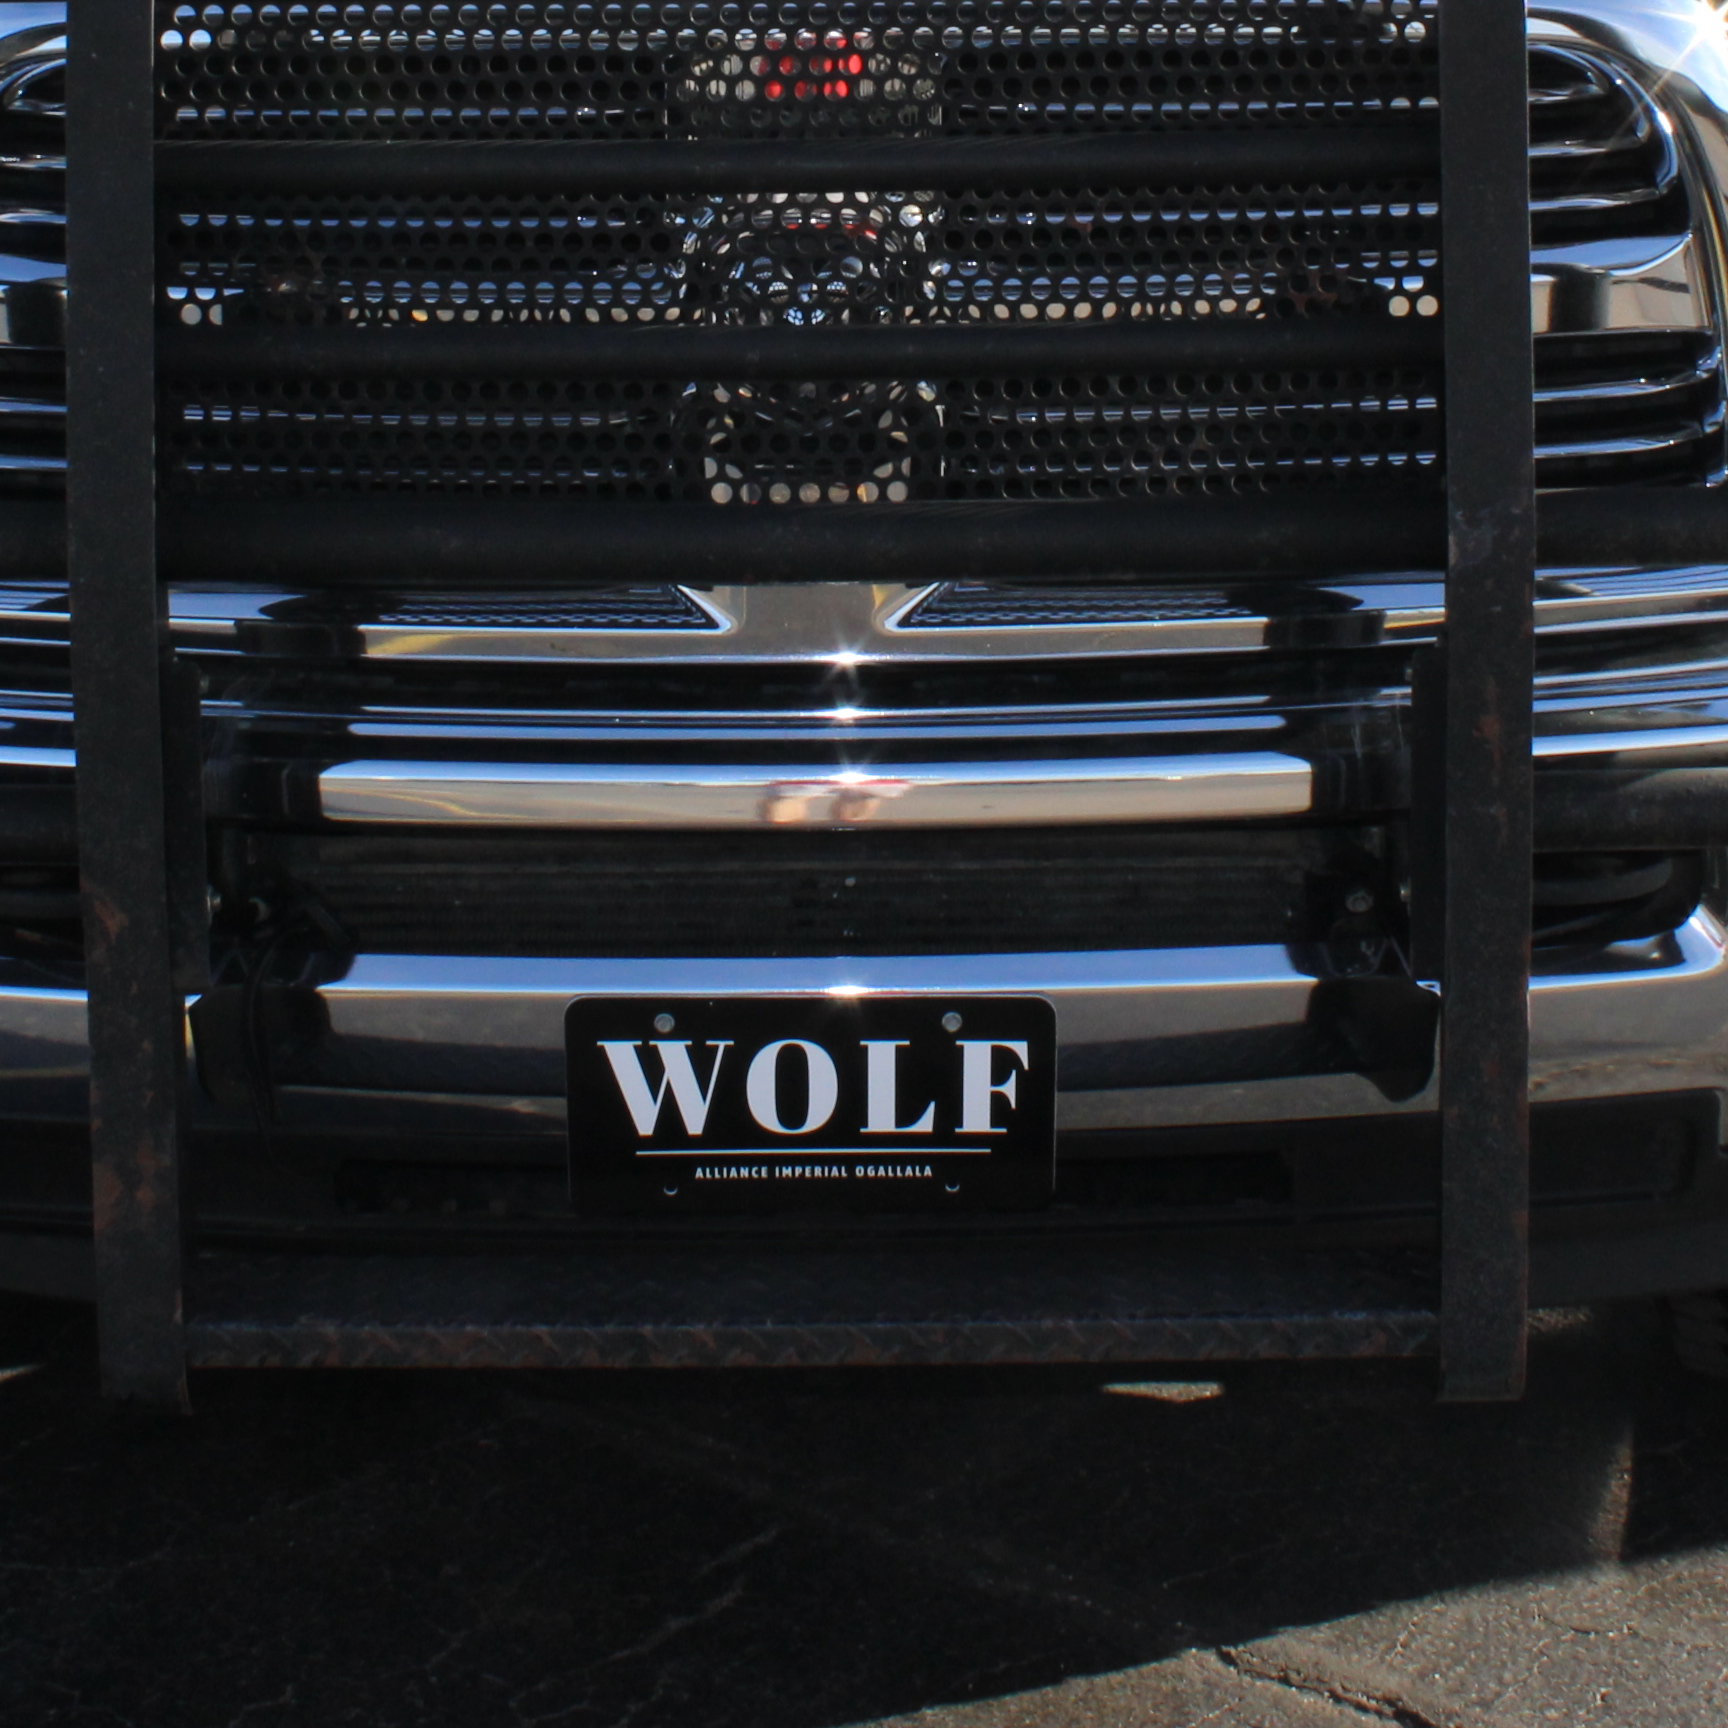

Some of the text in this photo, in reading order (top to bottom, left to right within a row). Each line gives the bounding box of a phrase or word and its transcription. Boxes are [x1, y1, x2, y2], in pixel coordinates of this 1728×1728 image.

[596, 1038, 1030, 1136] WOLF
[694, 1165, 933, 1179] ALLIANCE IMPERIAL OGALLALA
